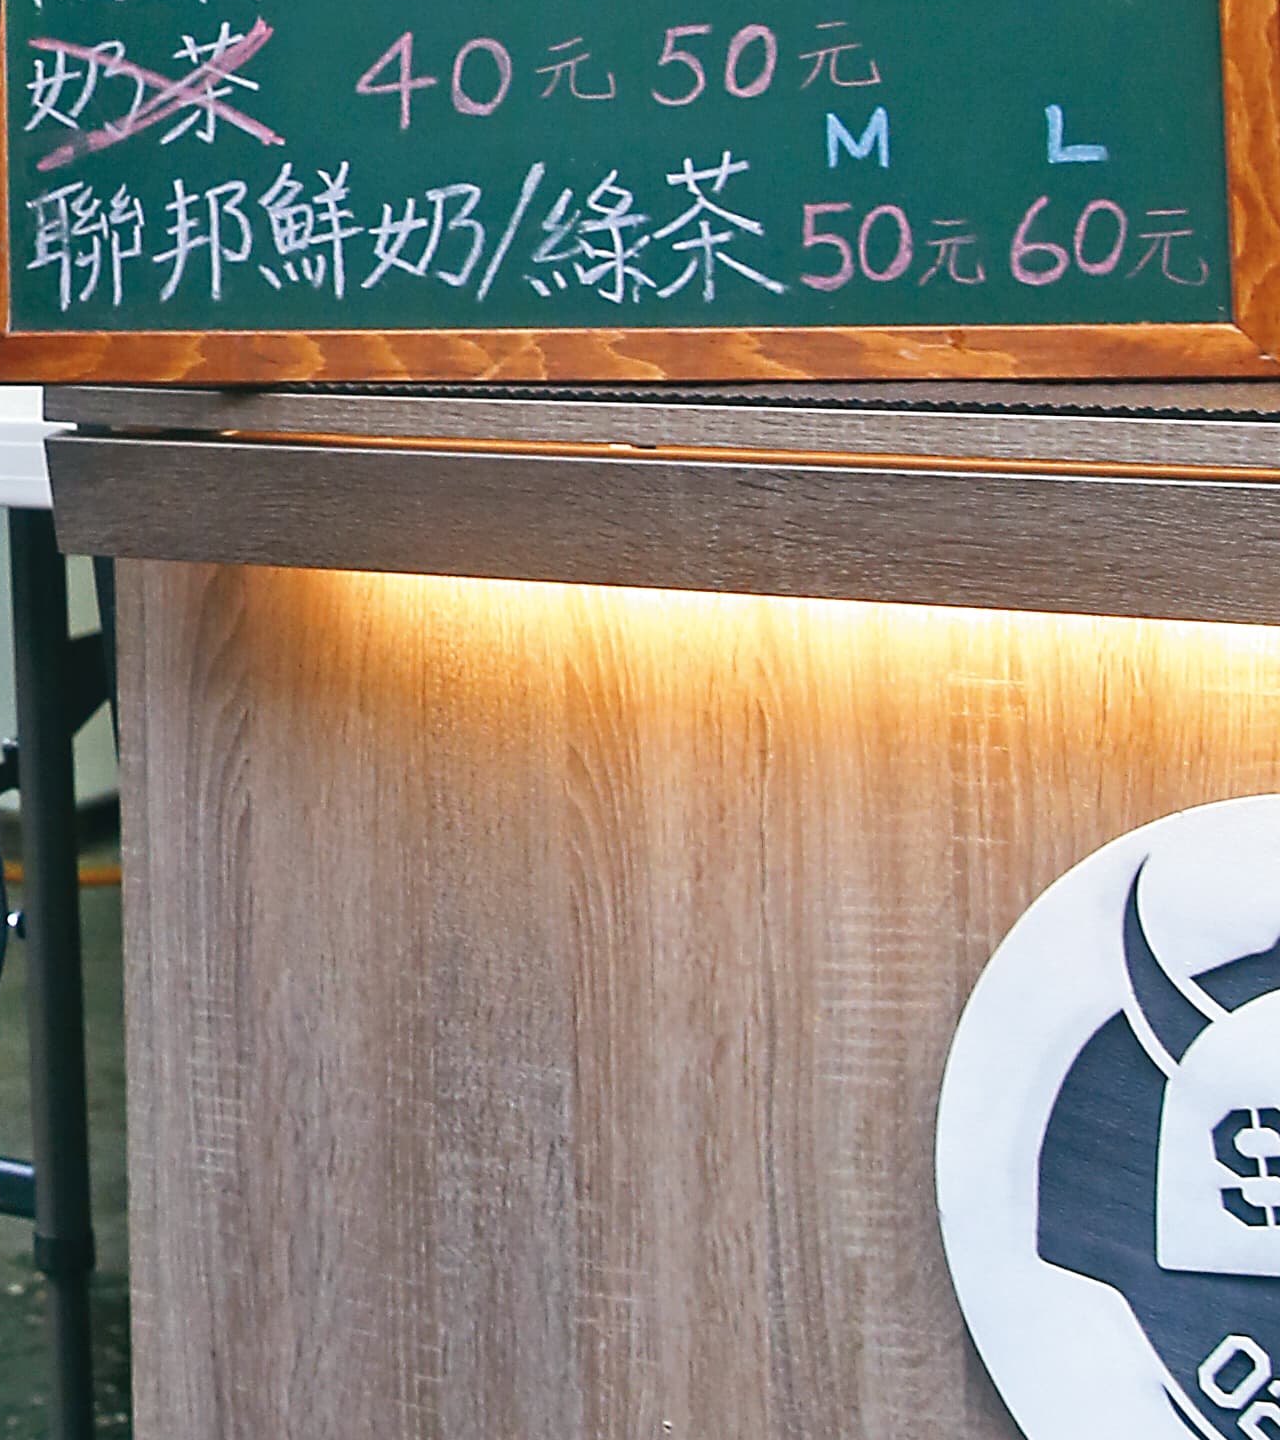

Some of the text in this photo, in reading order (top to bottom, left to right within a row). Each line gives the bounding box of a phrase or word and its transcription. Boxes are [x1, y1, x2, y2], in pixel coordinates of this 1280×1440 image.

[24, 21, 262, 146] 奶茶
[826, 103, 1110, 169] M L
